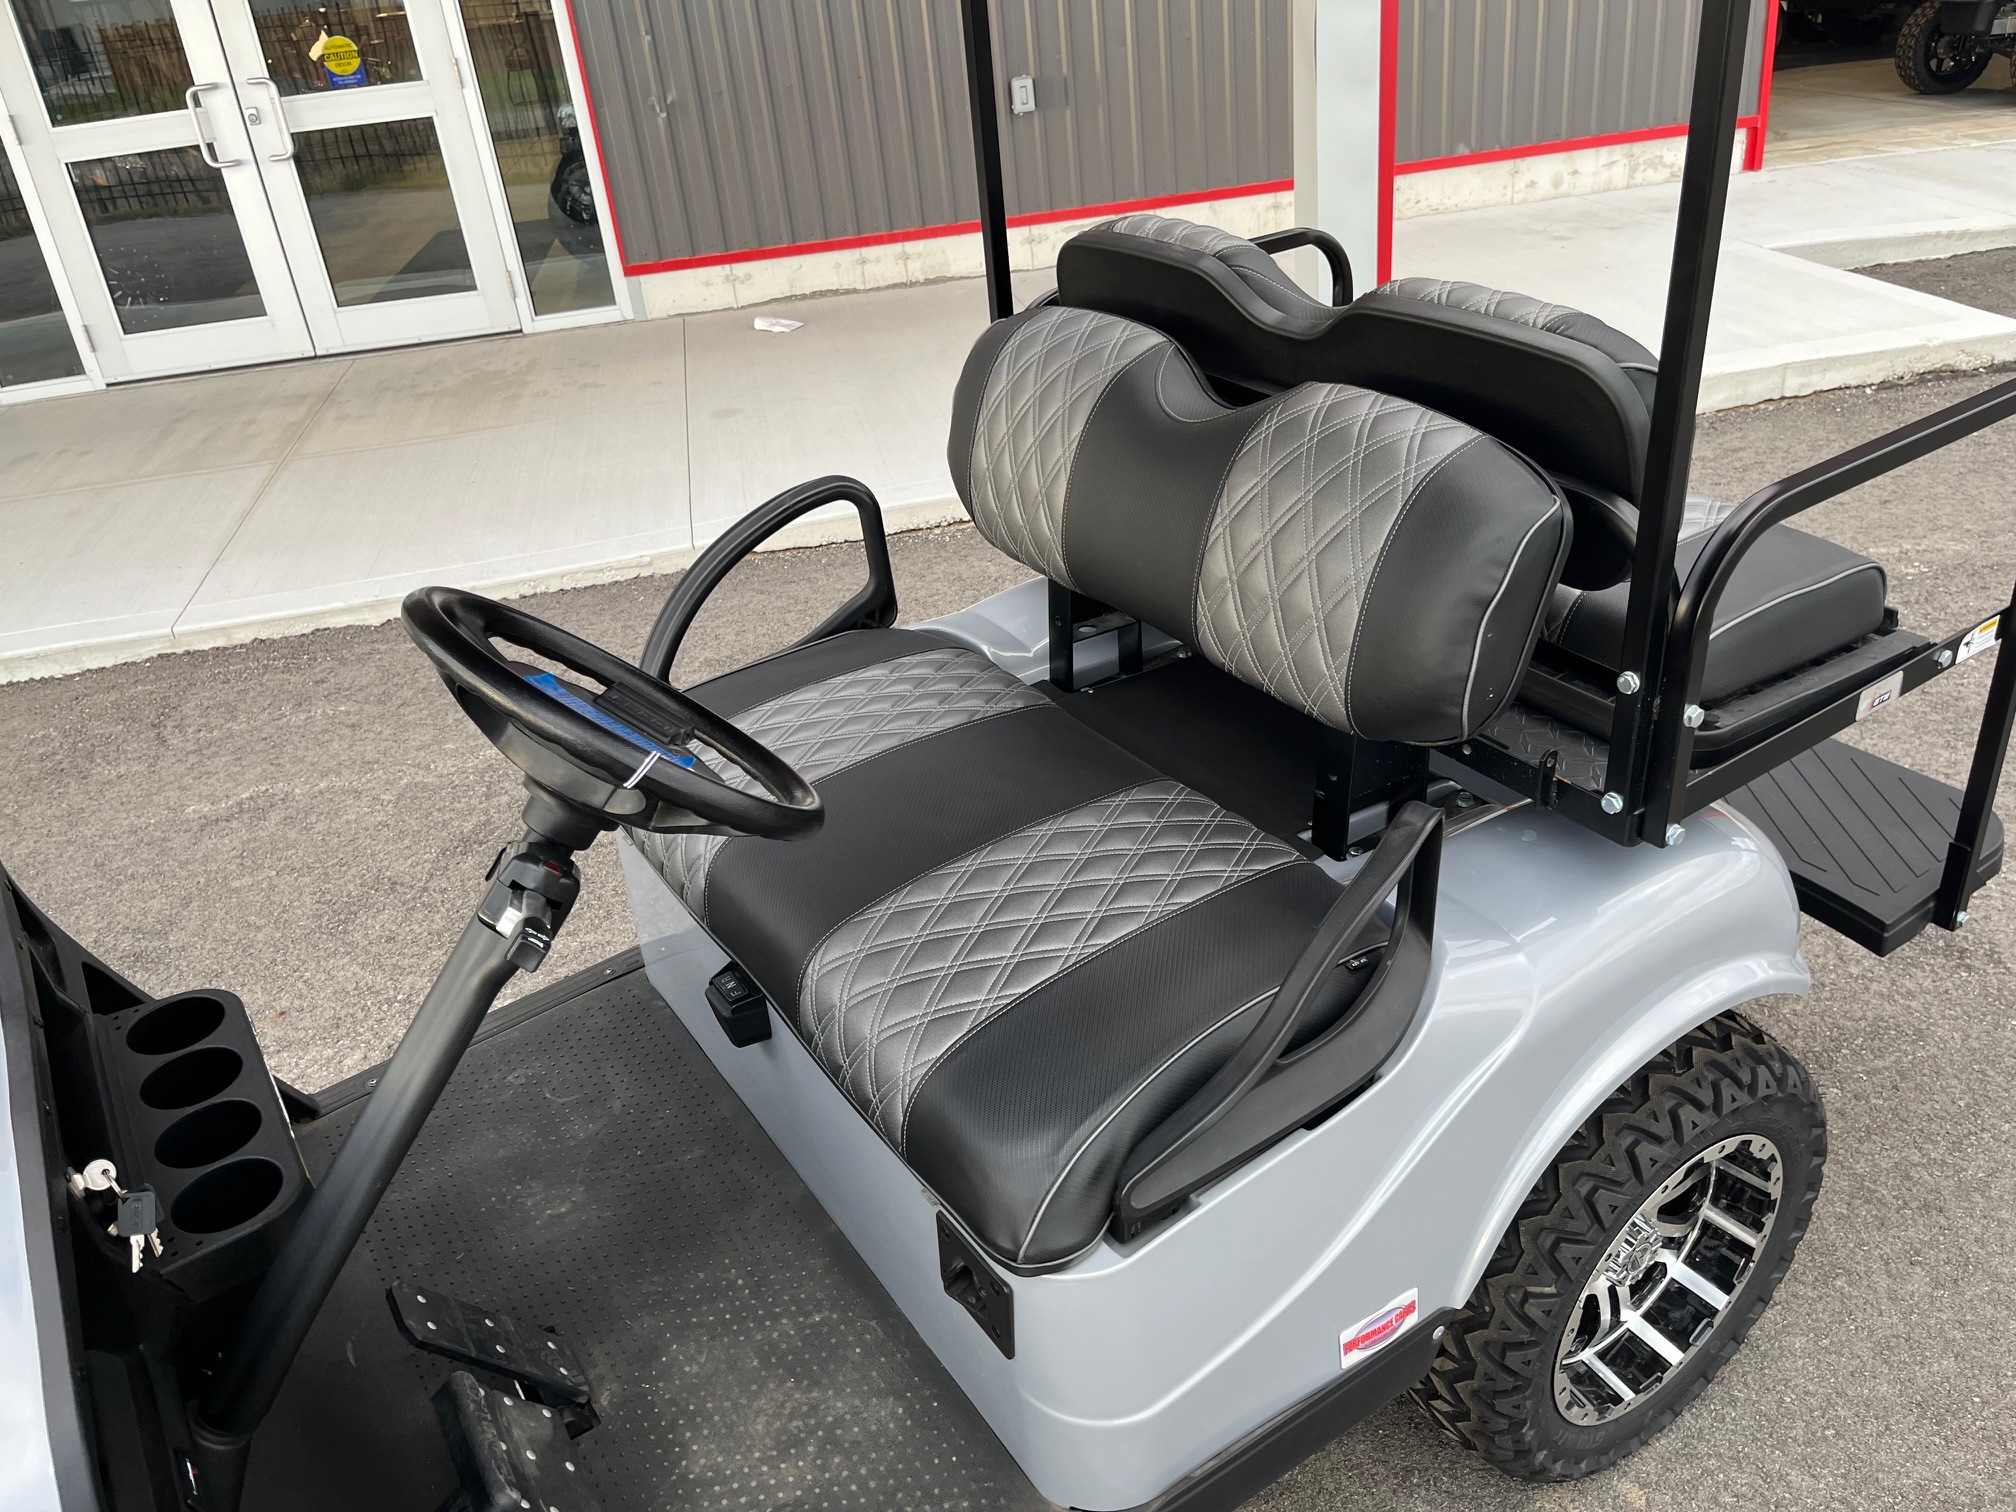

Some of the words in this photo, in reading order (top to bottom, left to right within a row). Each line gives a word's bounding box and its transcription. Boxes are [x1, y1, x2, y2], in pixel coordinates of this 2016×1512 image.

[324, 51, 358, 61] CAUTION
[725, 981, 737, 989] N
[1342, 1316, 1394, 1356] PERFORMANCE
